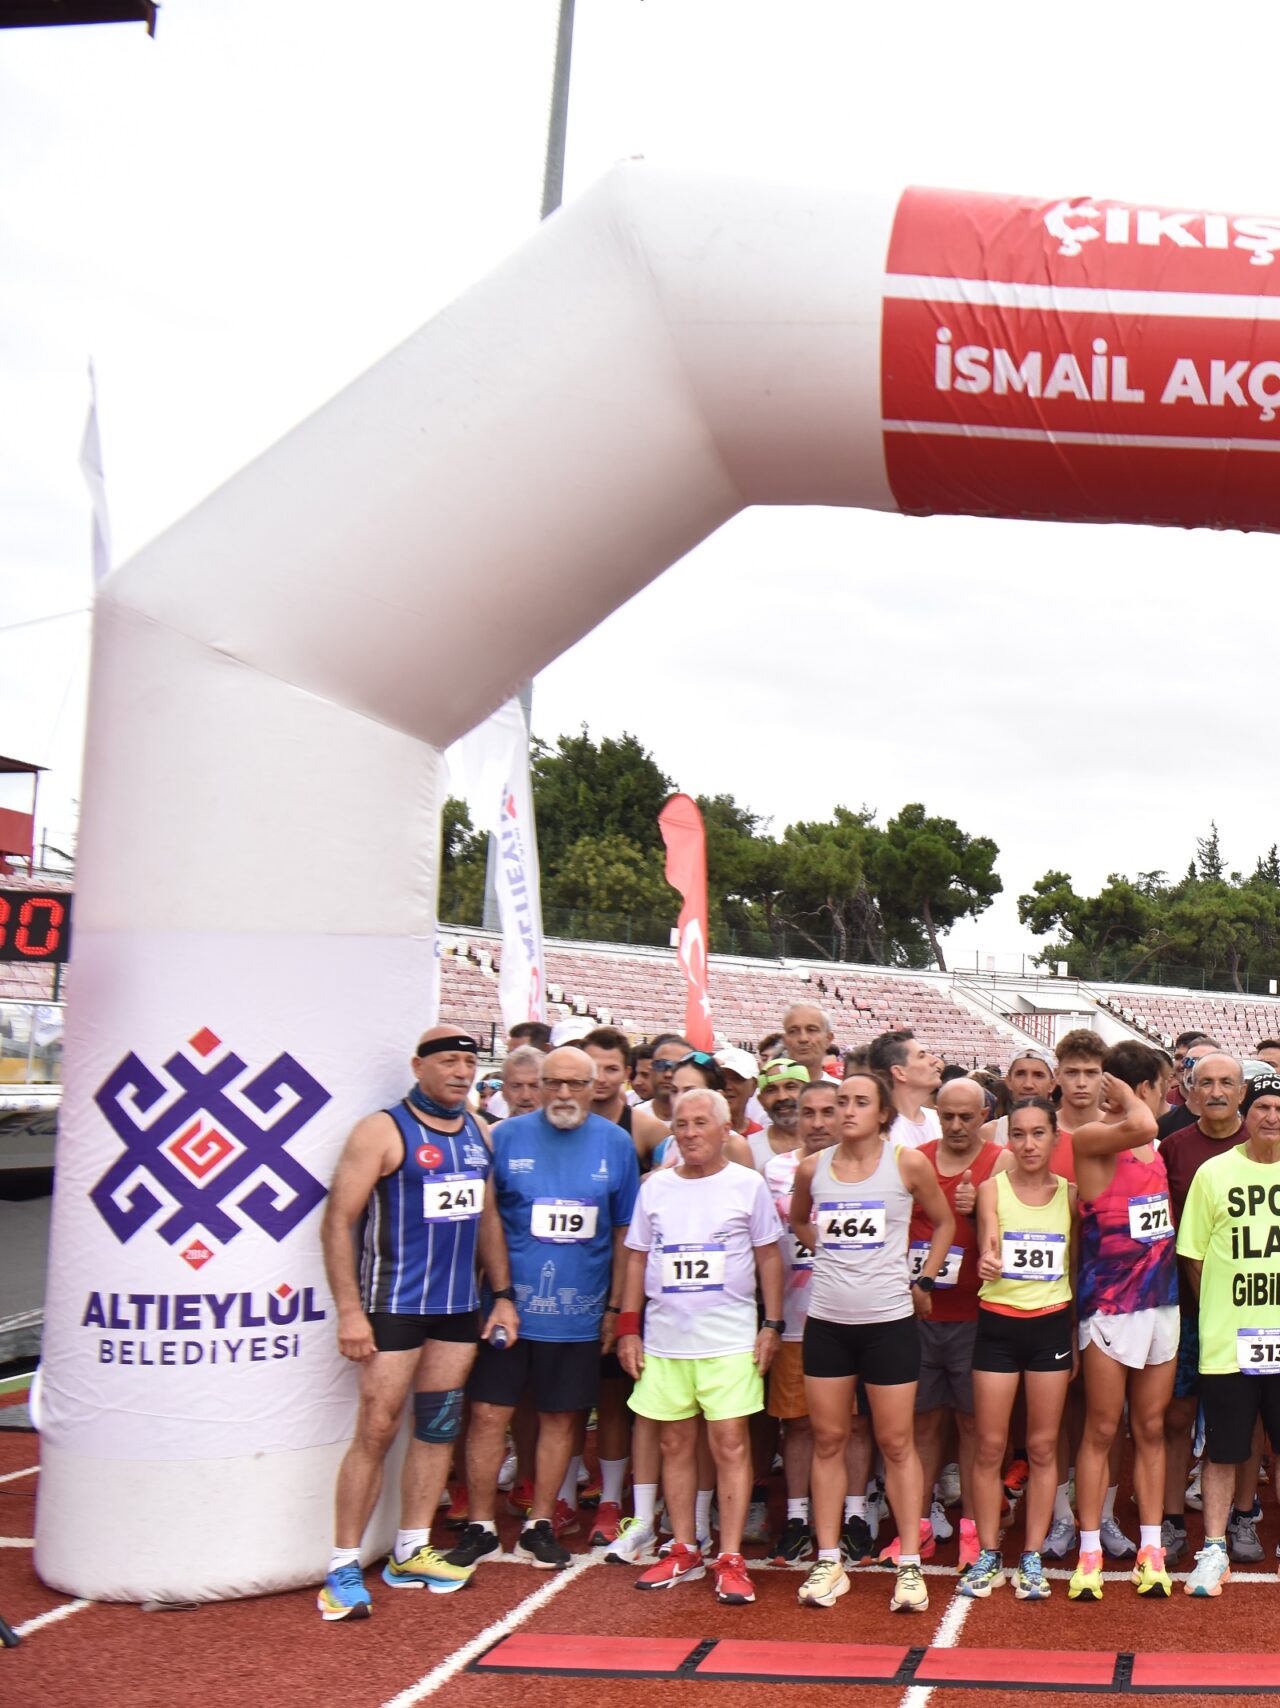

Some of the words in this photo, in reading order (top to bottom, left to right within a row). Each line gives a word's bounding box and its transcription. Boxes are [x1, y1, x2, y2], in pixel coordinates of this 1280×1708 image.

[936, 327, 1145, 403] İSMAİL
[438, 1188, 474, 1210] 241
[548, 1213, 583, 1233] 119
[827, 1218, 877, 1237] 464
[912, 1256, 949, 1277] 33
[1013, 1249, 1054, 1269] 381
[673, 1260, 709, 1279] 112
